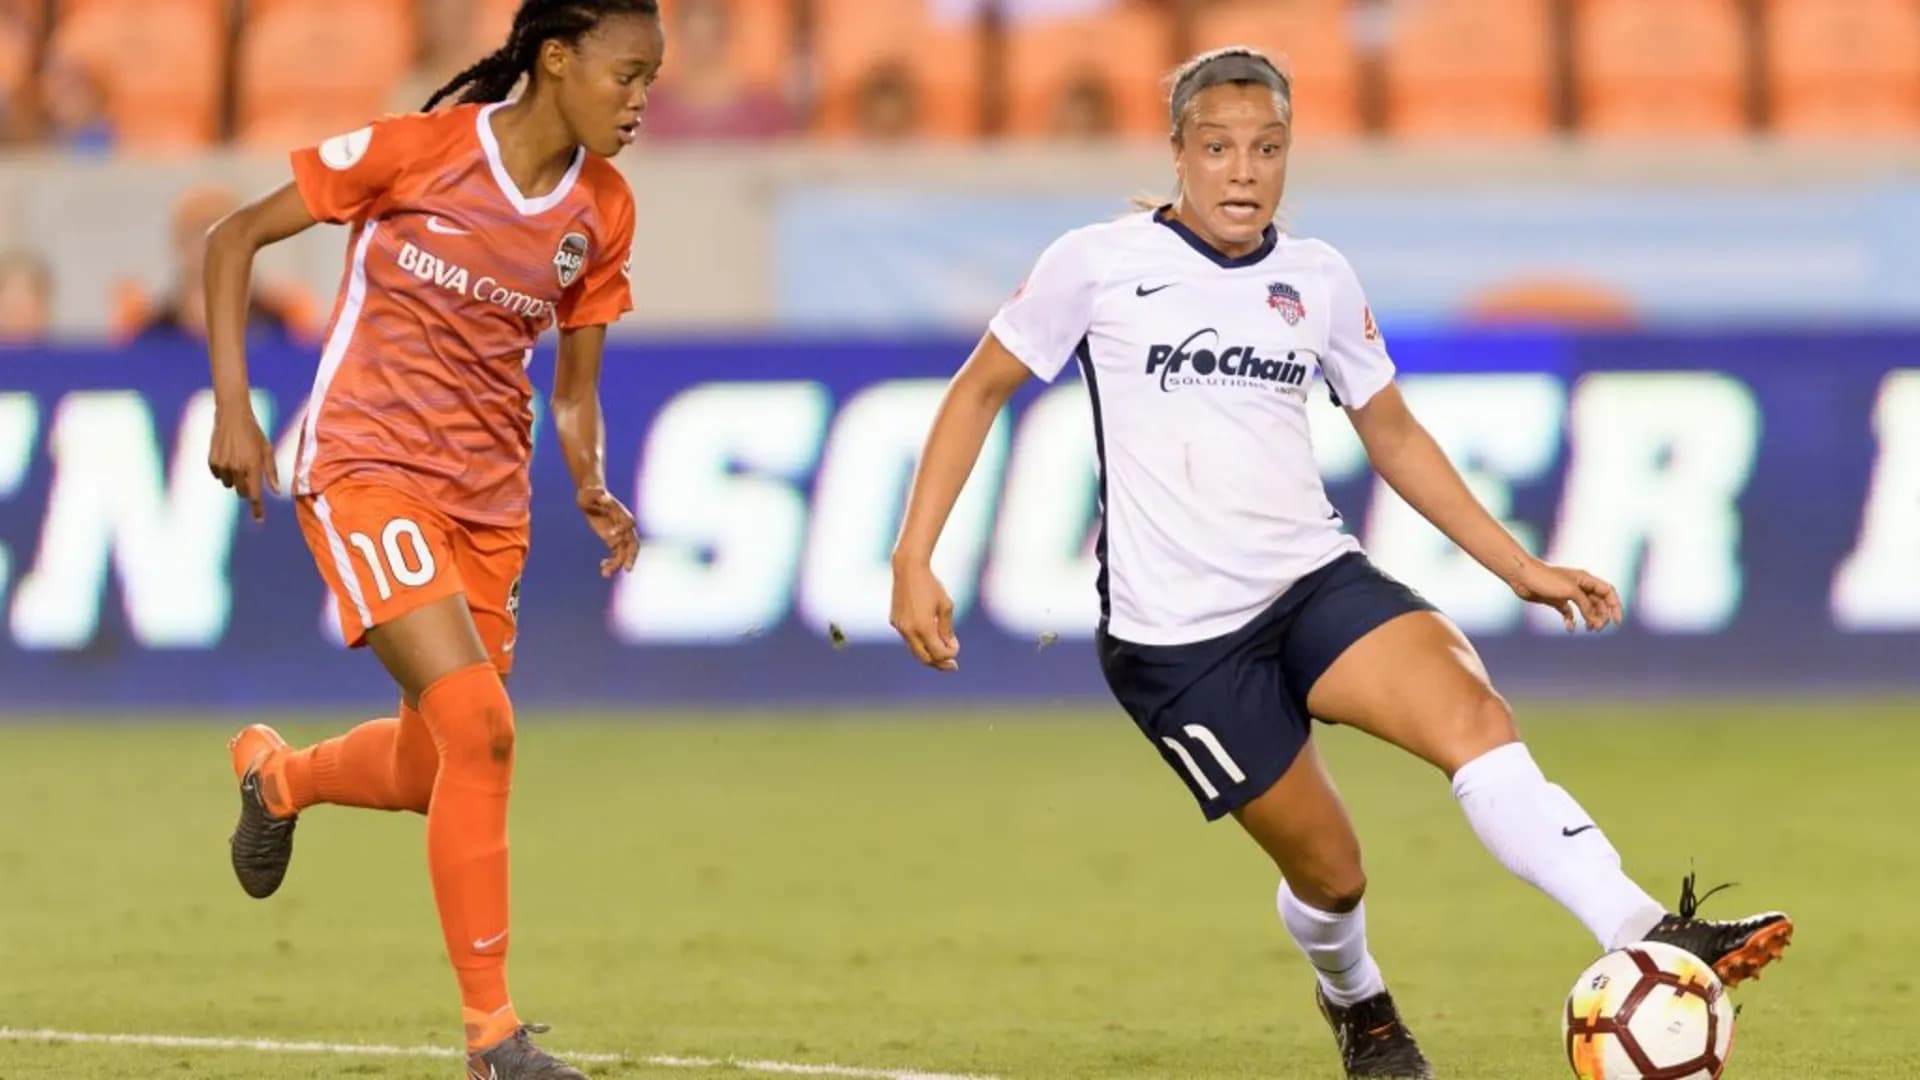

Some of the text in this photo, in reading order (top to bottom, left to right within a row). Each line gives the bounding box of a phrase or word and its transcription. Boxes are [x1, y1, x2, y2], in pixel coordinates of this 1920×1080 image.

[397, 242, 469, 295] BBVA
[1145, 344, 1307, 386] ProChain
[350, 518, 436, 601] 10
[1161, 723, 1247, 800] 11
